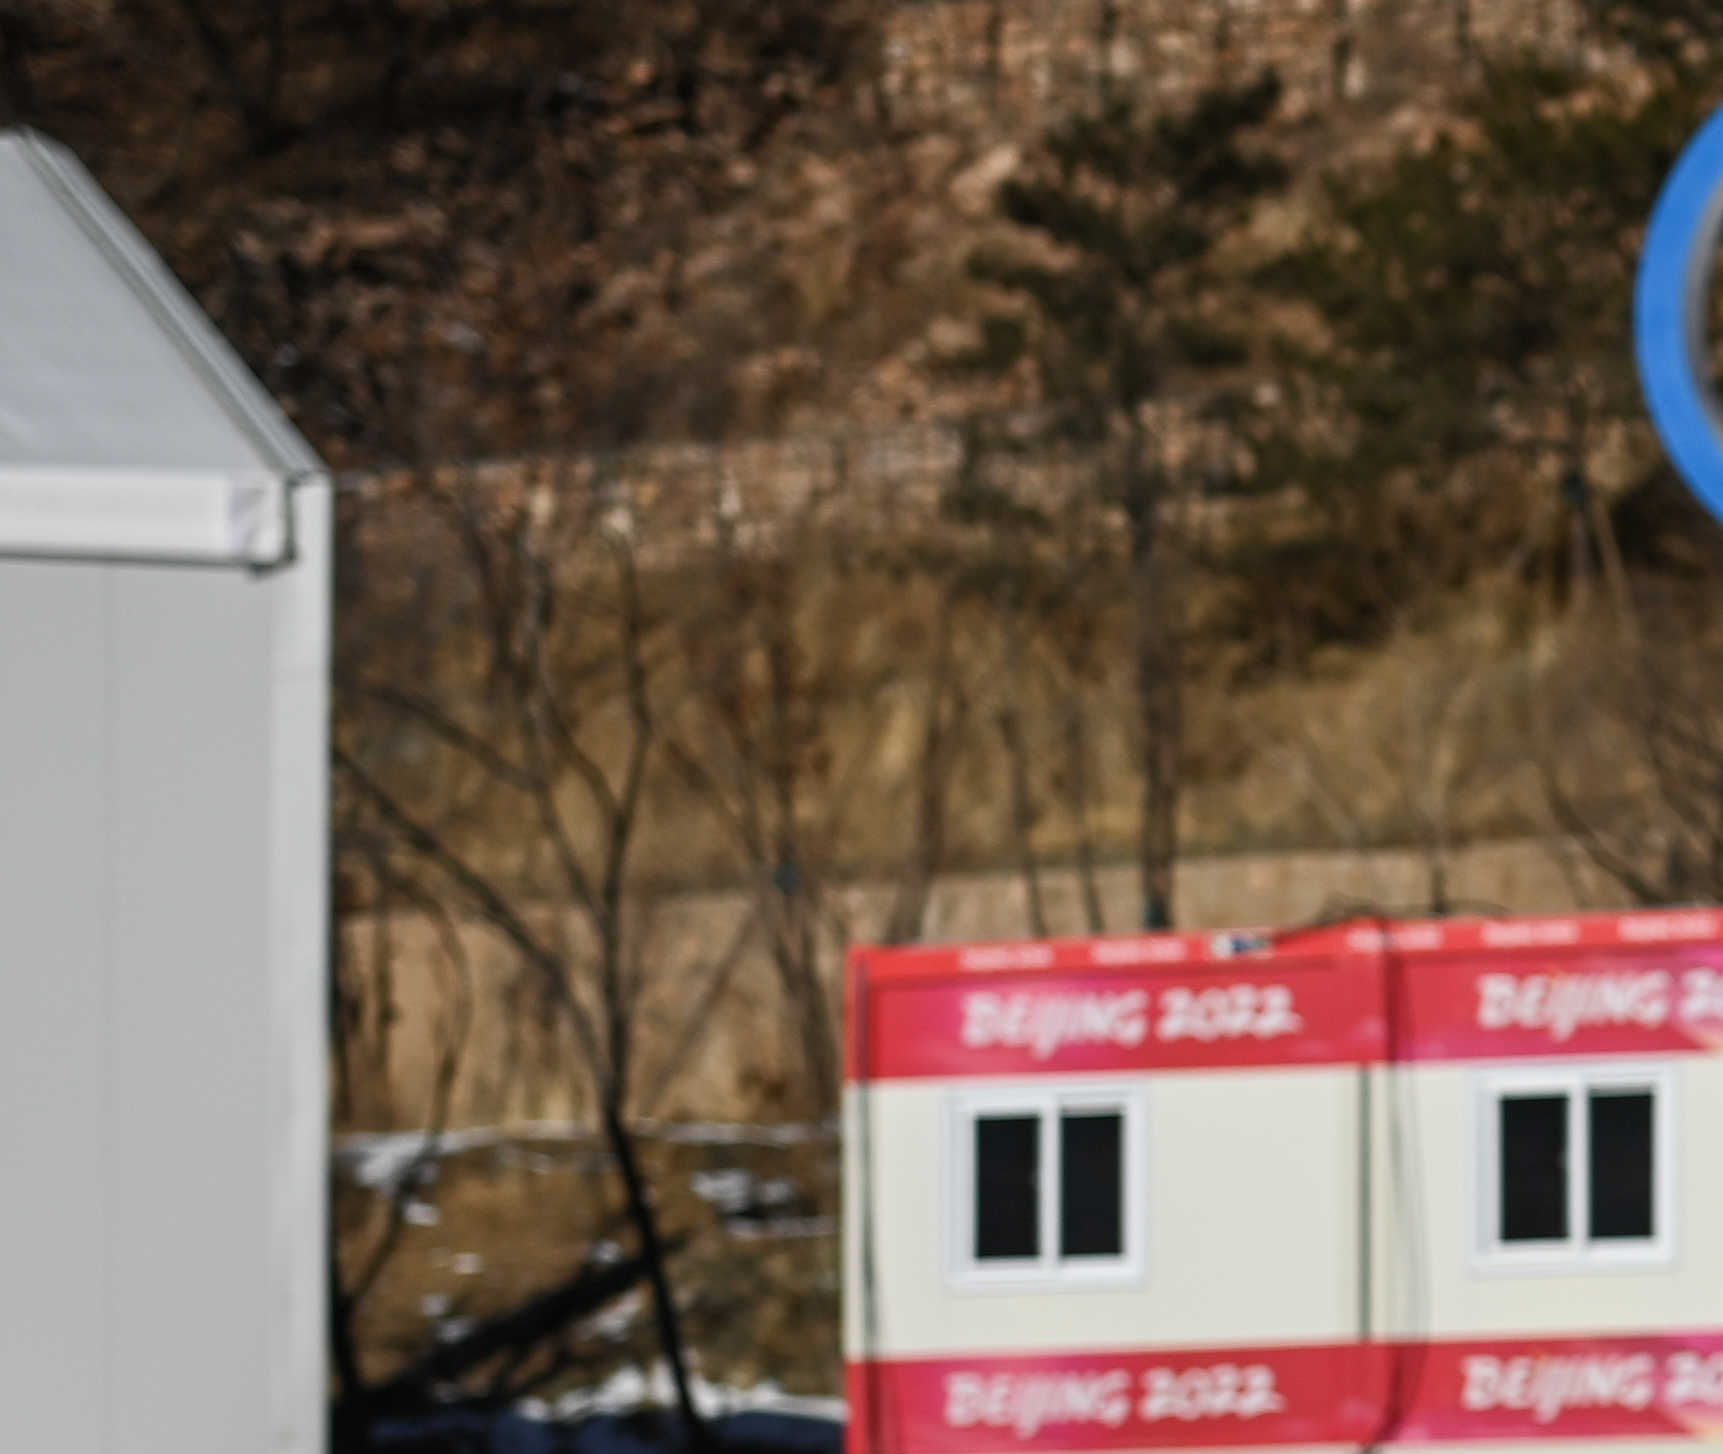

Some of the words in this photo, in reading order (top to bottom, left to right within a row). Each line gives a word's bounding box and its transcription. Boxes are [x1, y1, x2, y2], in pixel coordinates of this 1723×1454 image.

[962, 990, 1146, 1057] BEIJING
[1158, 985, 1299, 1039] 2022
[1478, 971, 1666, 1039] BEIJING
[946, 1372, 1129, 1426] BEIJING
[1140, 1365, 1281, 1419] 2022
[1463, 1354, 1654, 1421] BEIJING
